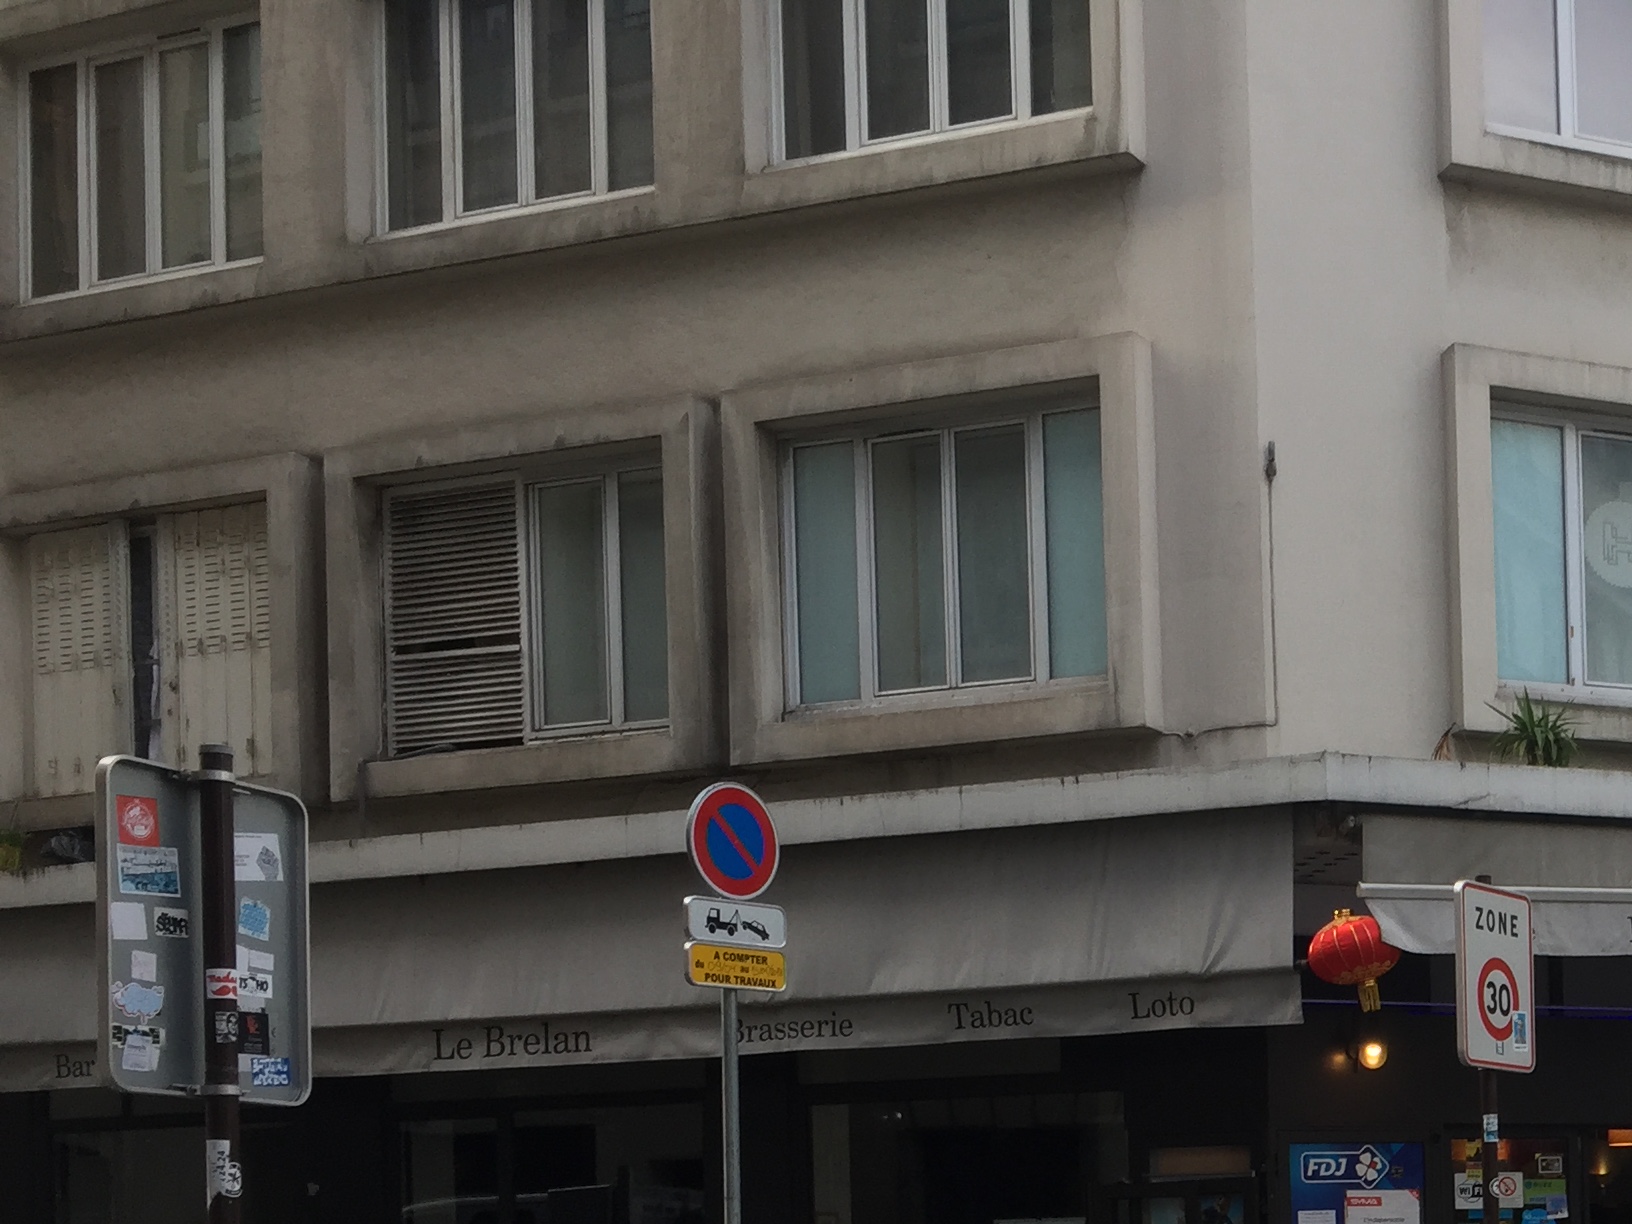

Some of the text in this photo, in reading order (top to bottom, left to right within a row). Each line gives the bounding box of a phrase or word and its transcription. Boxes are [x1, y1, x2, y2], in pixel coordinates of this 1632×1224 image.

[1475, 906, 1519, 938] ZONE
[695, 959, 704, 969] du
[740, 965, 749, 973] au
[713, 951, 768, 965] A COMPTER
[704, 973, 777, 988] POUR TRAVAUX
[1486, 980, 1511, 1017] 30
[54, 1052, 96, 1081] Bar
[432, 1028, 472, 1061] Le
[484, 1022, 593, 1059] Brelan
[947, 1001, 1034, 1031] Tabac
[1127, 991, 1196, 1021] Loto
[1307, 1158, 1348, 1176] FDJ
